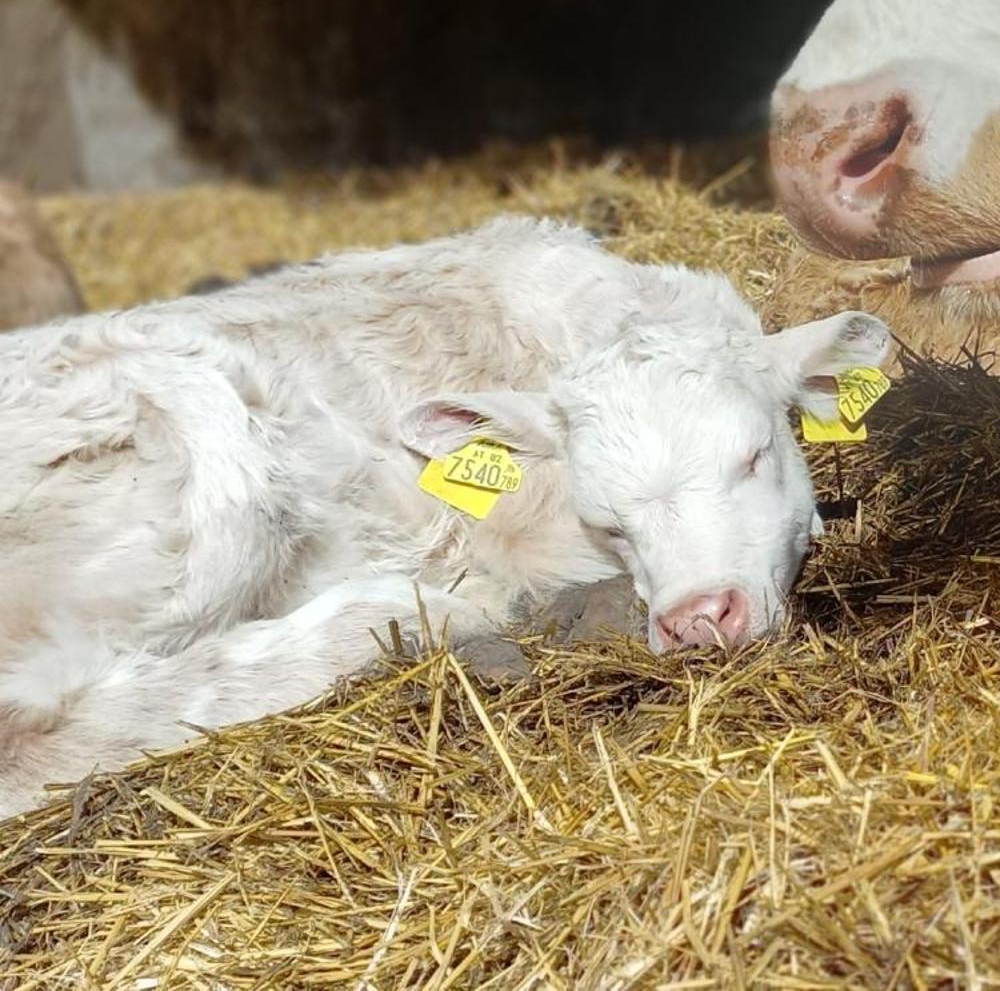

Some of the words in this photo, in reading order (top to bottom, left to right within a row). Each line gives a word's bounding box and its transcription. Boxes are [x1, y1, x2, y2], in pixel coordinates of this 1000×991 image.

[841, 379, 879, 419] 7540
[473, 450, 485, 459] AT
[447, 455, 502, 487] 7540
